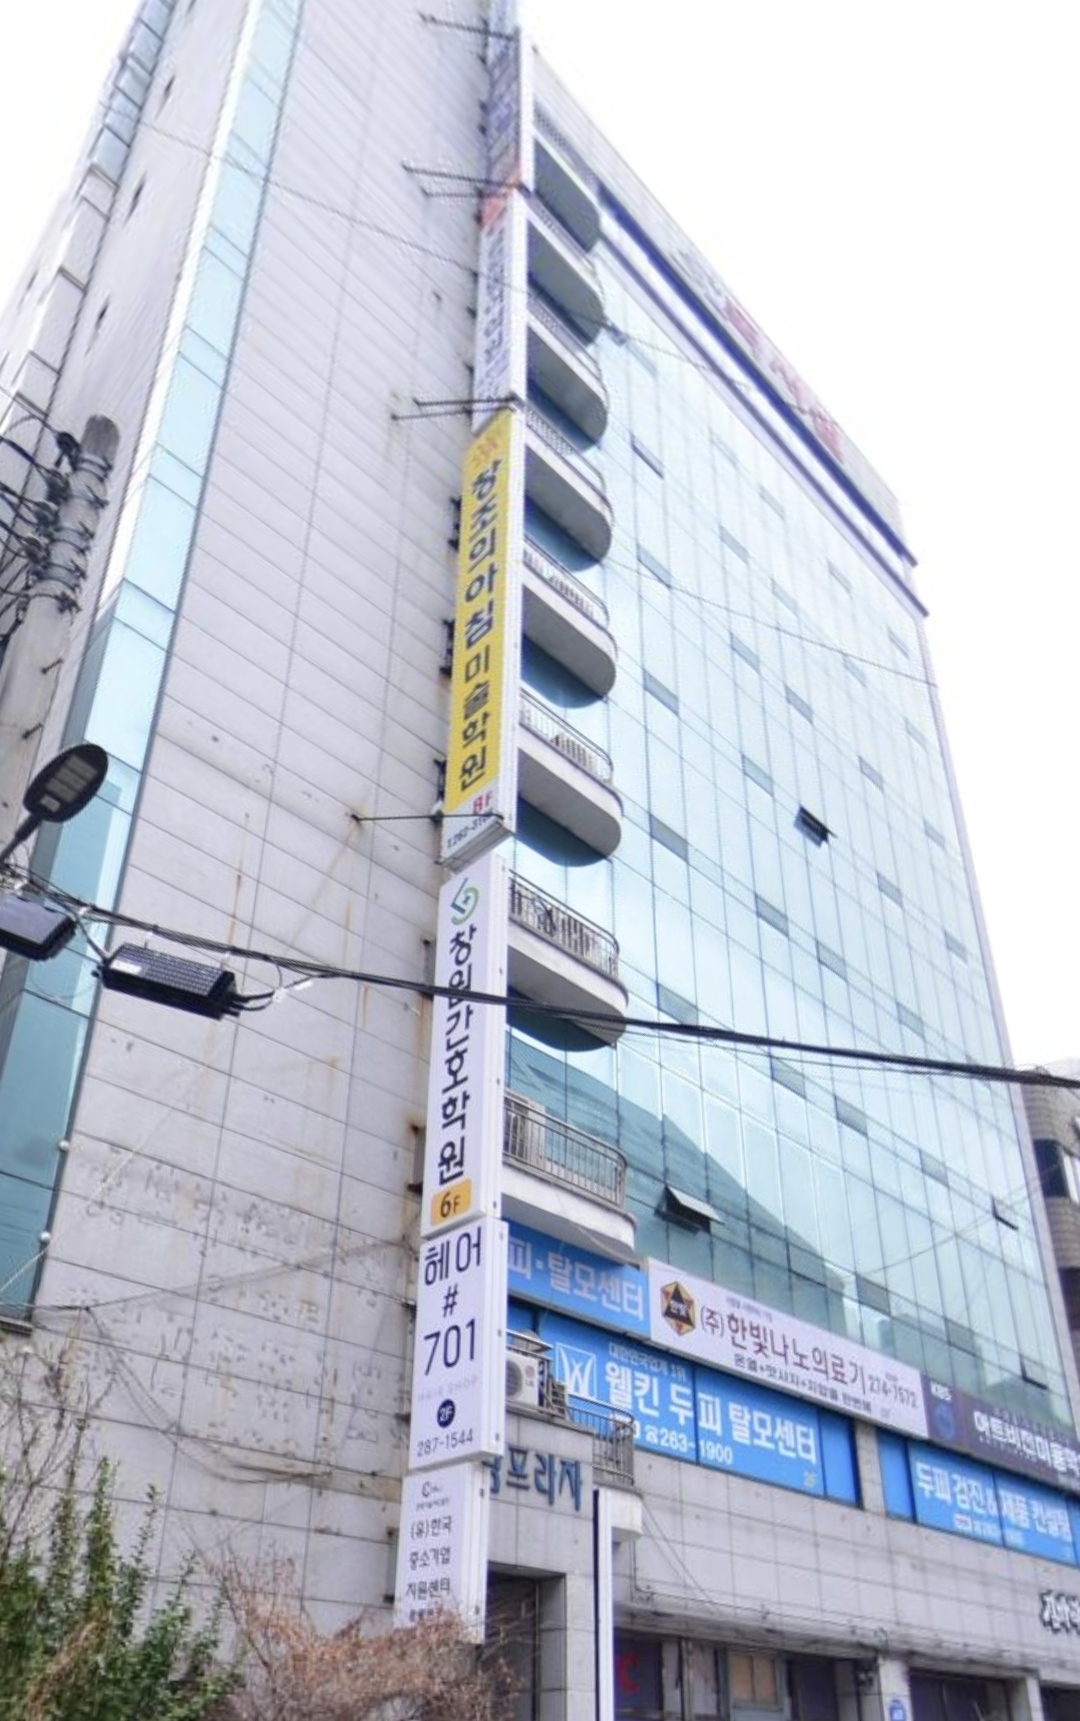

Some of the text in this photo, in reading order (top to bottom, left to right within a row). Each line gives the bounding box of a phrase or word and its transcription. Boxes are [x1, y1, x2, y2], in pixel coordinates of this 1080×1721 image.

[440, 1192, 461, 1219] 6F
[424, 1226, 482, 1286] 헤어
[424, 1318, 476, 1376] 701
[605, 1361, 659, 1417] 웰킨
[728, 1401, 817, 1465] 탈모센터
[417, 1428, 473, 1458] 287-1544
